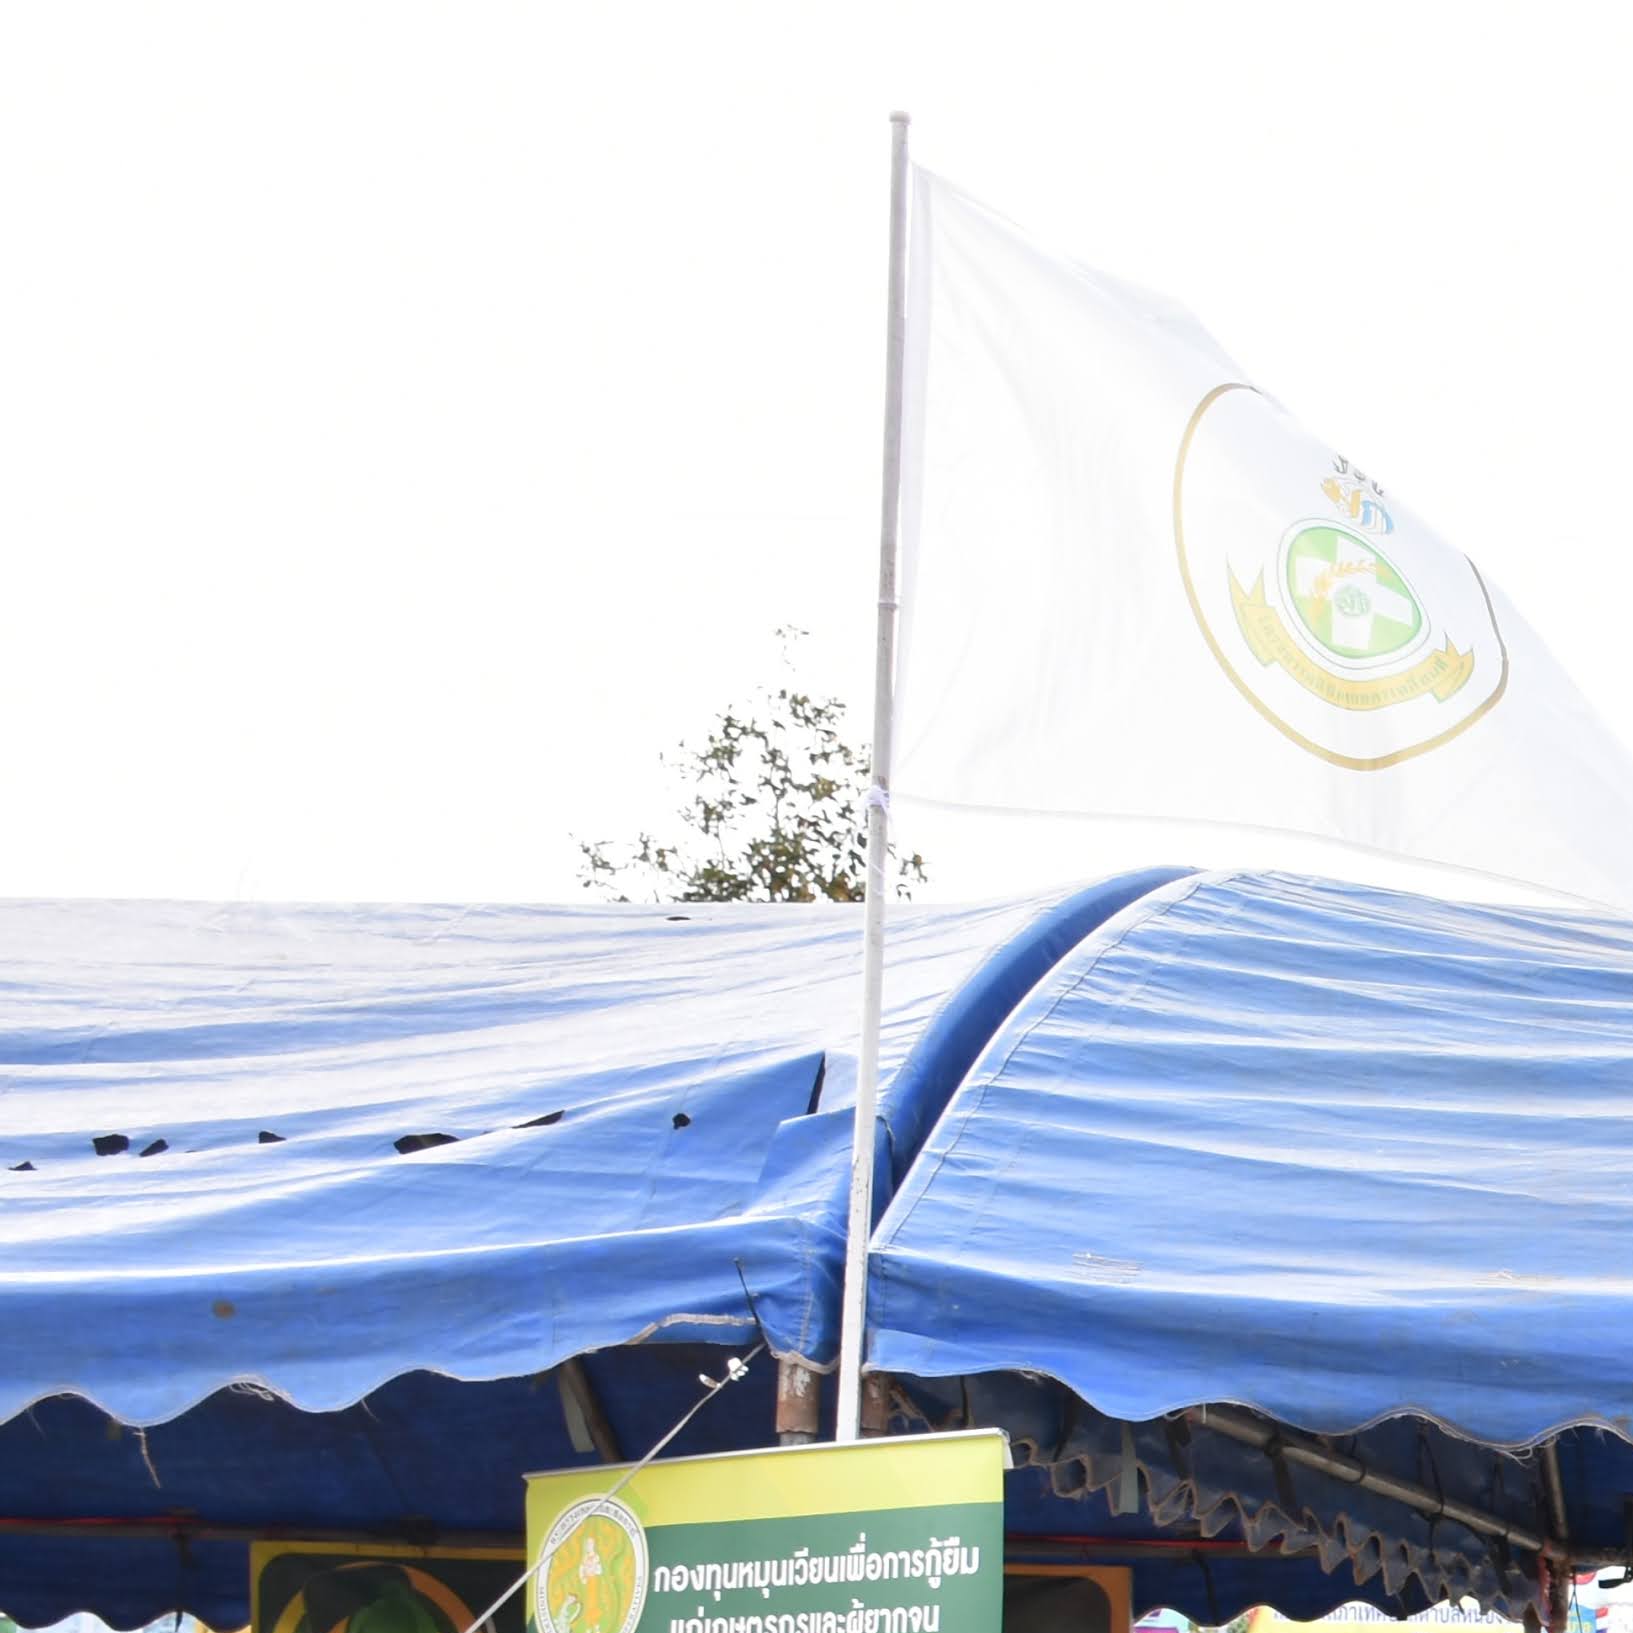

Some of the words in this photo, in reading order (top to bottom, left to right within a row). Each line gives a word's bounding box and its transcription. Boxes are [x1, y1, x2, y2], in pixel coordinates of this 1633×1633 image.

[654, 1533, 980, 1601] กองทุนหมุนเวียนเพื่อการกู้ยืม
